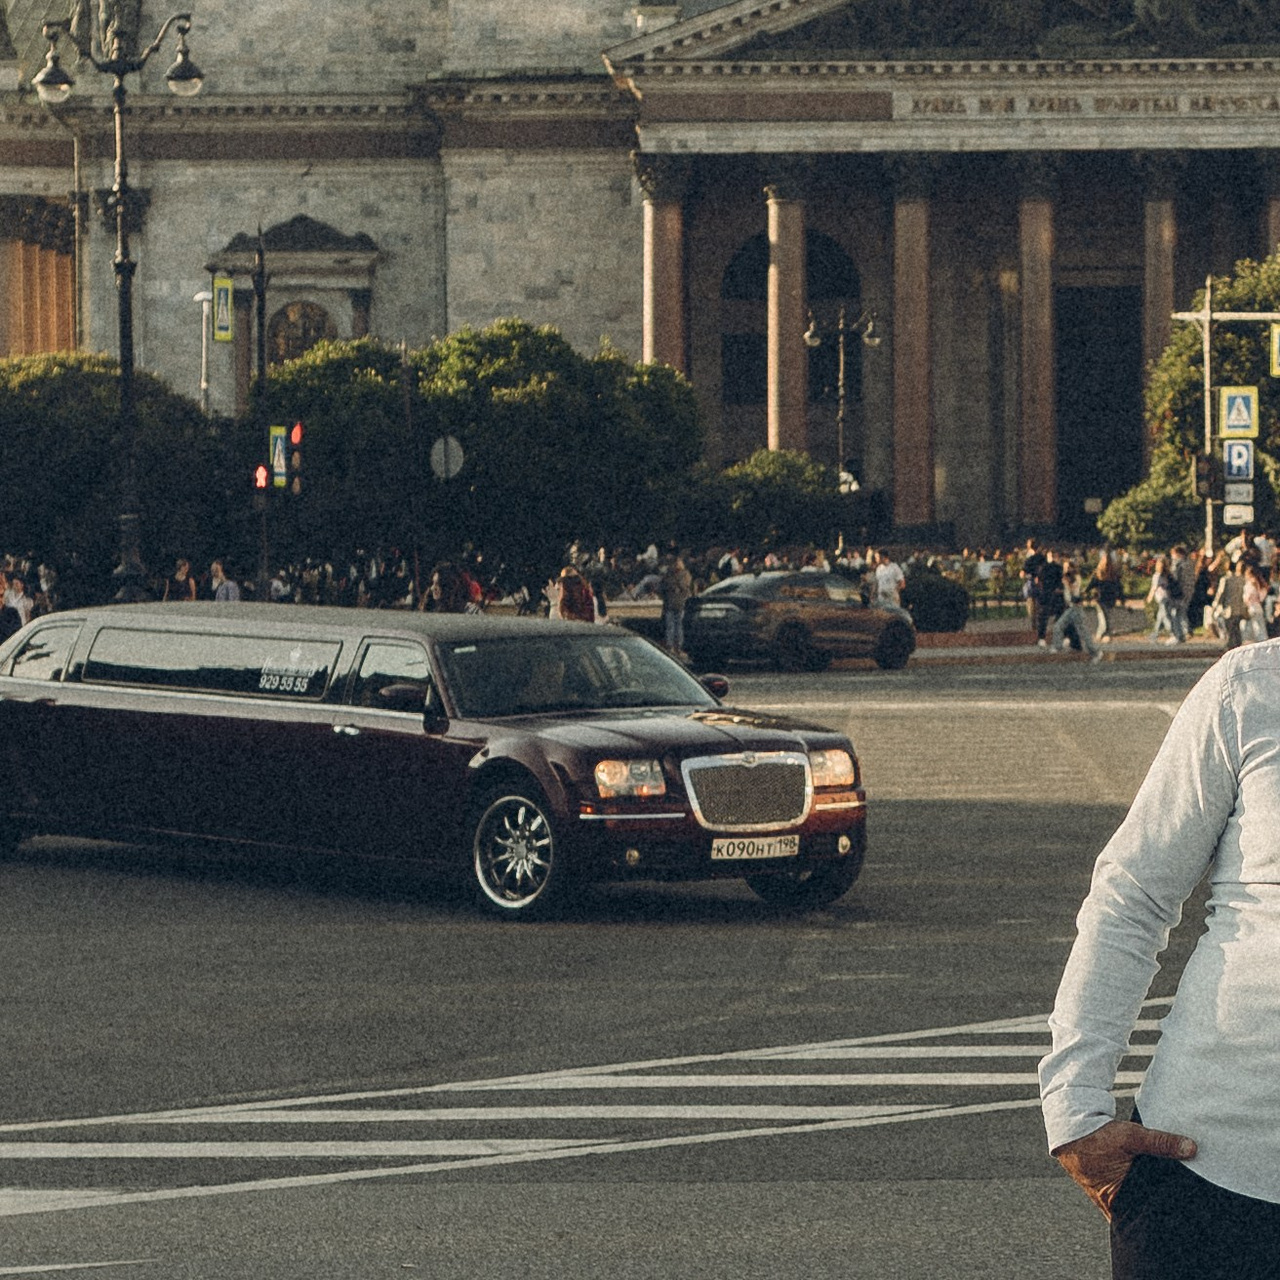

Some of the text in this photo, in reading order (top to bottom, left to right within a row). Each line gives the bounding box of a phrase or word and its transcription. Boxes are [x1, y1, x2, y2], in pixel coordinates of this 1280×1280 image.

[259, 674, 309, 692] 929 55 55
